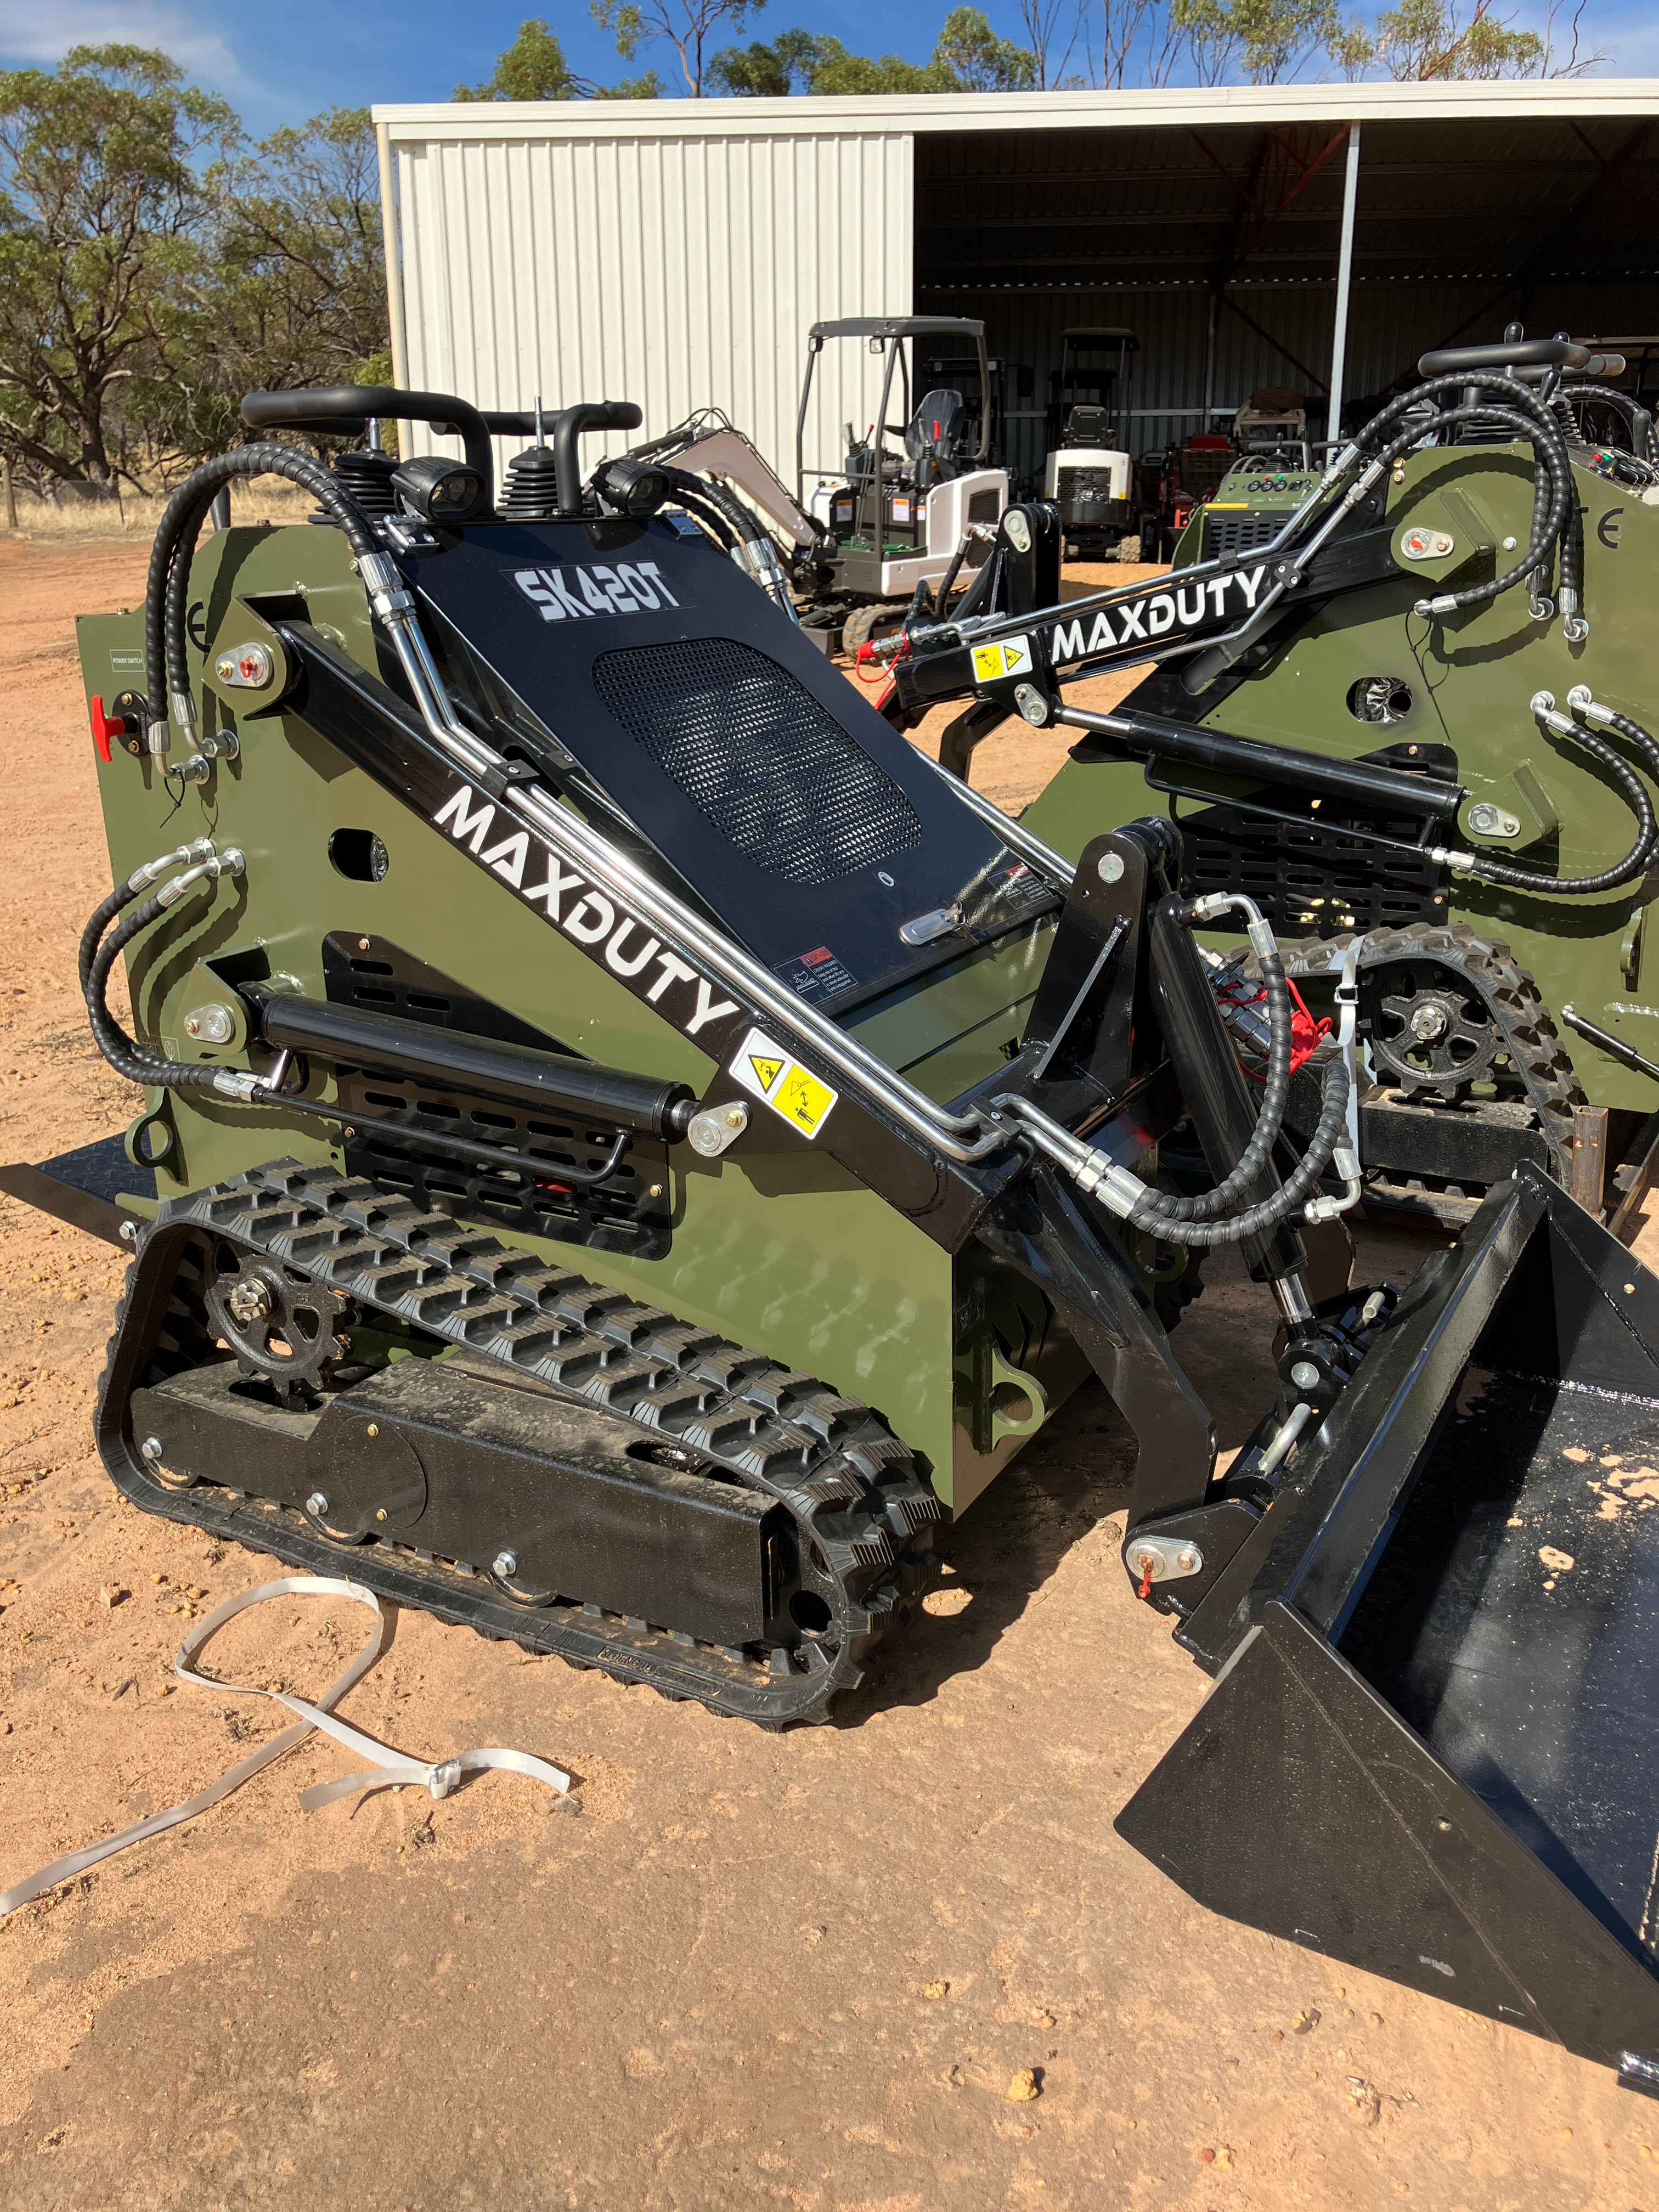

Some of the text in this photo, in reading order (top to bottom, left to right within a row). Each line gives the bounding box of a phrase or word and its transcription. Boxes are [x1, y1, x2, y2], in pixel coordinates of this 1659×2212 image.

[515, 562, 680, 620] SK420T
[1052, 565, 1266, 664] MAXDUTY
[433, 785, 741, 1035] MAXDUTY
[811, 950, 828, 961] DANGER
